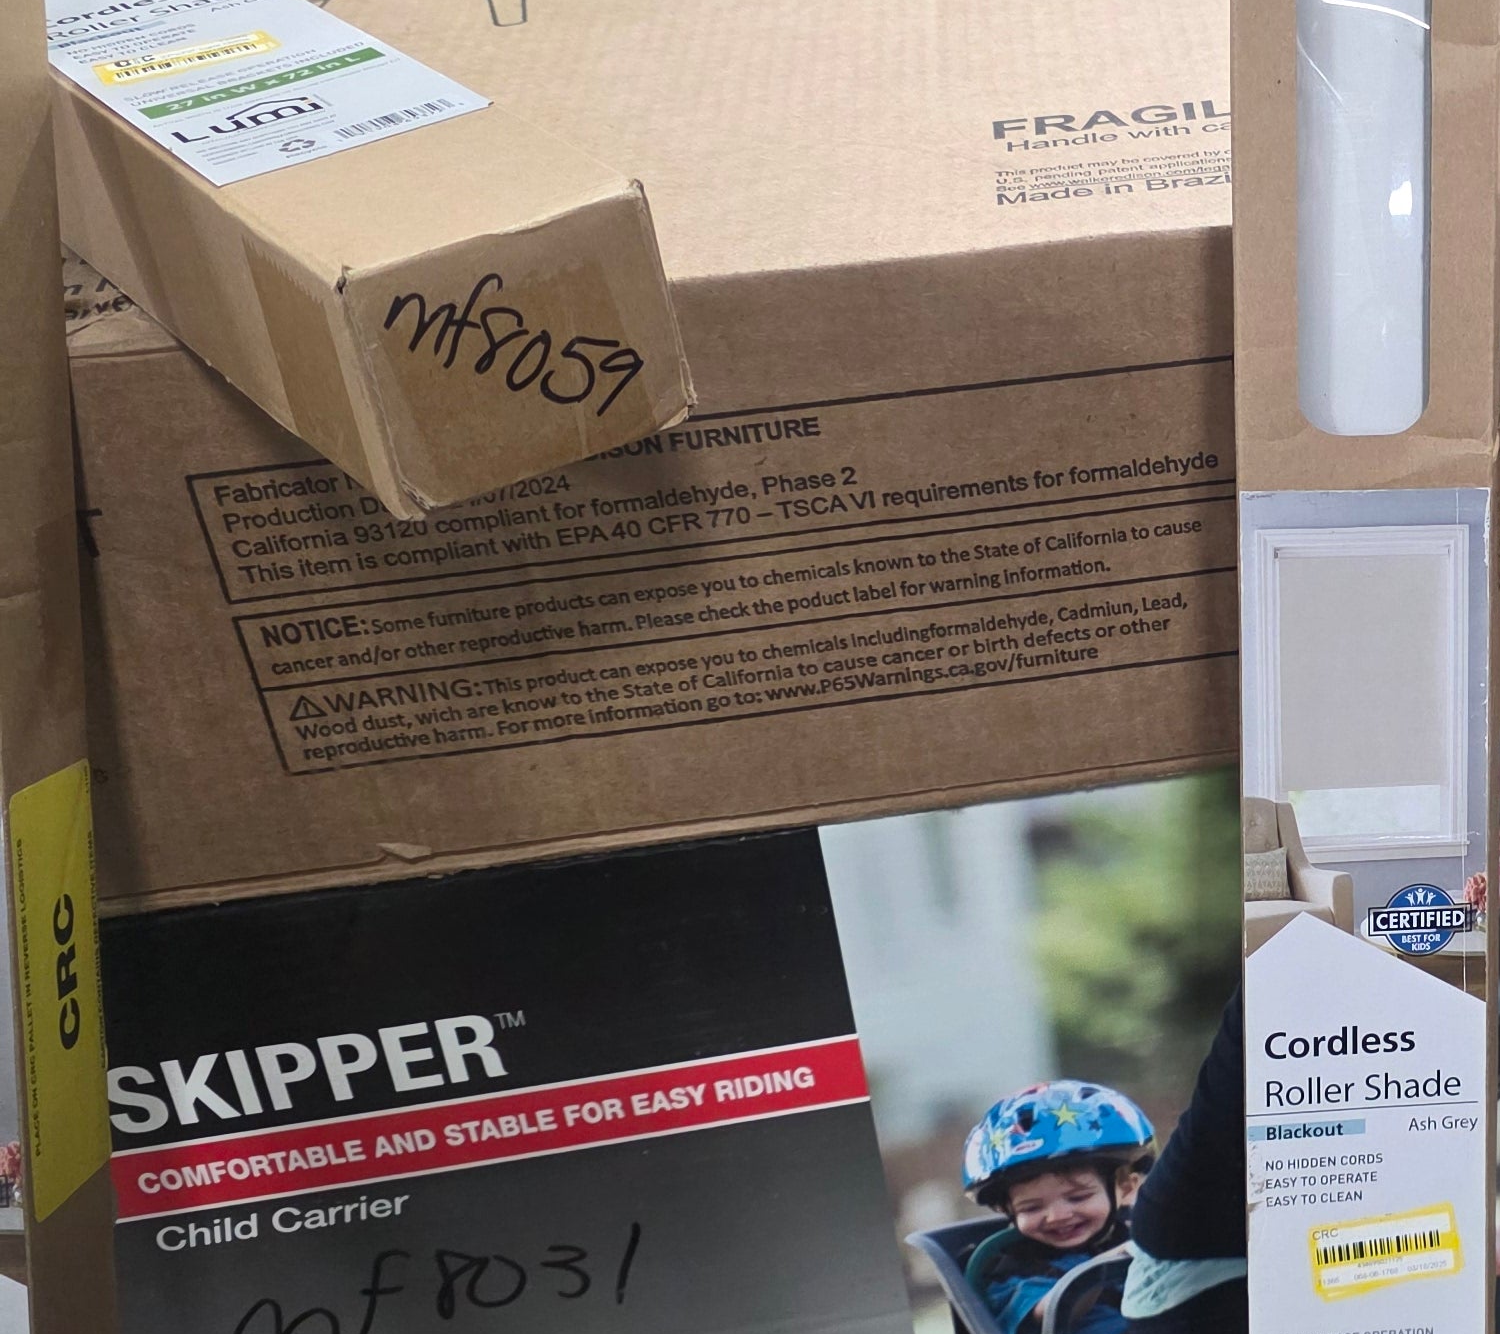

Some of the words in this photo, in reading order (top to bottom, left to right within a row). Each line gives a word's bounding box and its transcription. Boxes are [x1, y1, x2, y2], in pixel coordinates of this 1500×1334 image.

[210, 2, 241, 13] Ash
[47, 15, 140, 41] Roller
[165, 100, 193, 112] 27
[231, 84, 256, 94] W
[287, 68, 314, 80] 72
[992, 100, 1230, 140] FRAGIL
[1007, 132, 1118, 152] Handle
[1128, 124, 1190, 139] with
[996, 187, 1093, 206] Made
[1105, 183, 1134, 195] in
[1146, 172, 1230, 191] Brazi
[670, 416, 821, 451] FURNITURE
[214, 476, 338, 507] Fabricator
[223, 503, 354, 533] Production
[233, 529, 349, 558] California
[355, 520, 427, 544] 93120
[435, 505, 551, 536] compliant
[555, 504, 585, 521] for
[591, 480, 757, 518] formaldehyde,
[761, 471, 836, 494] Phase
[840, 466, 857, 486] 2
[239, 562, 294, 584] This
[300, 557, 352, 578] item
[357, 553, 378, 570] is
[384, 540, 499, 572] compliant
[502, 531, 551, 554] with
[557, 525, 609, 547] EPA
[612, 521, 642, 540] 40
[648, 513, 702, 536] CFR
[706, 507, 751, 529] 770
[775, 495, 848, 520] TSCA
[855, 490, 875, 510] VI
[882, 475, 1029, 509] requirements
[1033, 469, 1064, 489] for
[1070, 452, 1219, 485] formaldehyde
[260, 615, 370, 648] NOTICE:
[372, 618, 425, 635] Some
[428, 606, 510, 628] furniture
[515, 592, 596, 618] products
[598, 591, 630, 606] can
[634, 583, 698, 603] expose
[701, 579, 736, 596] you
[739, 573, 759, 589] to
[763, 561, 850, 586] chemicals
[853, 554, 913, 576] known
[917, 551, 937, 568] to
[941, 549, 971, 565] the
[974, 544, 1019, 561] State
[1024, 537, 1043, 555] of
[1046, 530, 1127, 552] California
[1131, 526, 1150, 541] to
[1154, 519, 1202, 537] cause
[324, 678, 482, 713] WARNING:
[1376, 908, 1466, 930] CERTIFIED
[1401, 933, 1421, 944] BEST
[1423, 932, 1441, 942] FOR
[1411, 941, 1431, 952] KIDS
[52, 892, 81, 1051] CRC
[1264, 1025, 1416, 1060] Cordless
[1266, 1076, 1356, 1108] Roller
[1364, 1069, 1462, 1101] Shade
[138, 1139, 366, 1195] COMFORTABLE
[374, 1129, 436, 1159] AND
[445, 1108, 558, 1147] STABLE
[563, 1098, 626, 1128] FOR
[631, 1083, 707, 1116] EASY
[715, 1066, 816, 1102] RIDING
[1266, 1122, 1345, 1141] Blackout
[1408, 1117, 1437, 1132] Ash
[1441, 1115, 1479, 1133] Grey
[1265, 1159, 1285, 1171] NO
[1288, 1156, 1336, 1170] HIDDEN
[1341, 1153, 1383, 1166] CORDS
[1265, 1177, 1297, 1190] EASY
[1301, 1176, 1317, 1187] TO
[1320, 1171, 1378, 1186] OPERATE
[1266, 1194, 1298, 1208] EASY
[1301, 1193, 1317, 1205] TO
[1320, 1190, 1363, 1204] CLEAN
[156, 1213, 259, 1252] Child
[272, 1194, 410, 1234] Carrier
[1312, 1228, 1339, 1242] CRC
